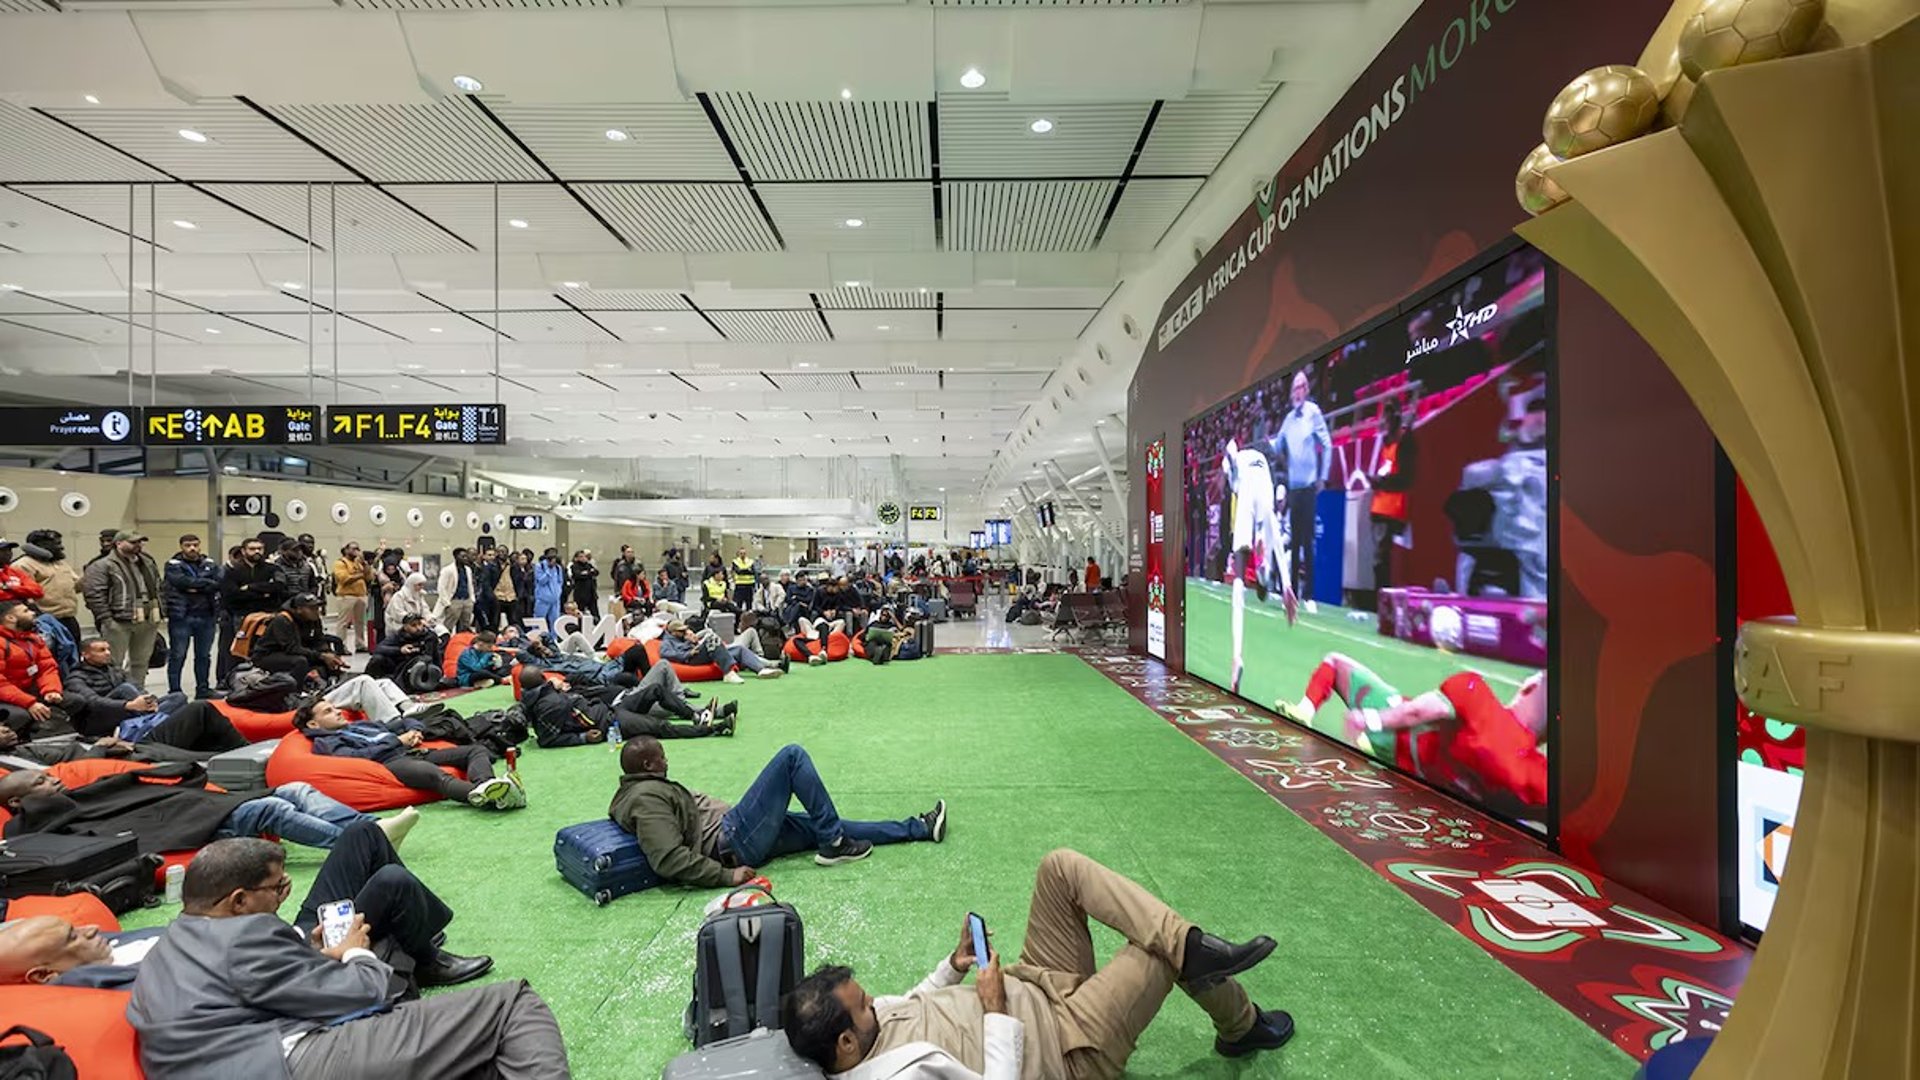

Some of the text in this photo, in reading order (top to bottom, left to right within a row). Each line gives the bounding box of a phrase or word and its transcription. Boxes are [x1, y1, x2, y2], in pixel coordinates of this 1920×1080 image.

[1205, 0, 1516, 305] AFRICA CUP OF NATIONS MOR
[1172, 295, 1197, 333] CAF
[1404, 337, 1439, 364] مباشر
[167, 413, 184, 439] E
[435, 420, 458, 431] Gate
[478, 407, 498, 424] T1
[50, 425, 100, 435] Prayer room
[288, 421, 311, 432] Gate
